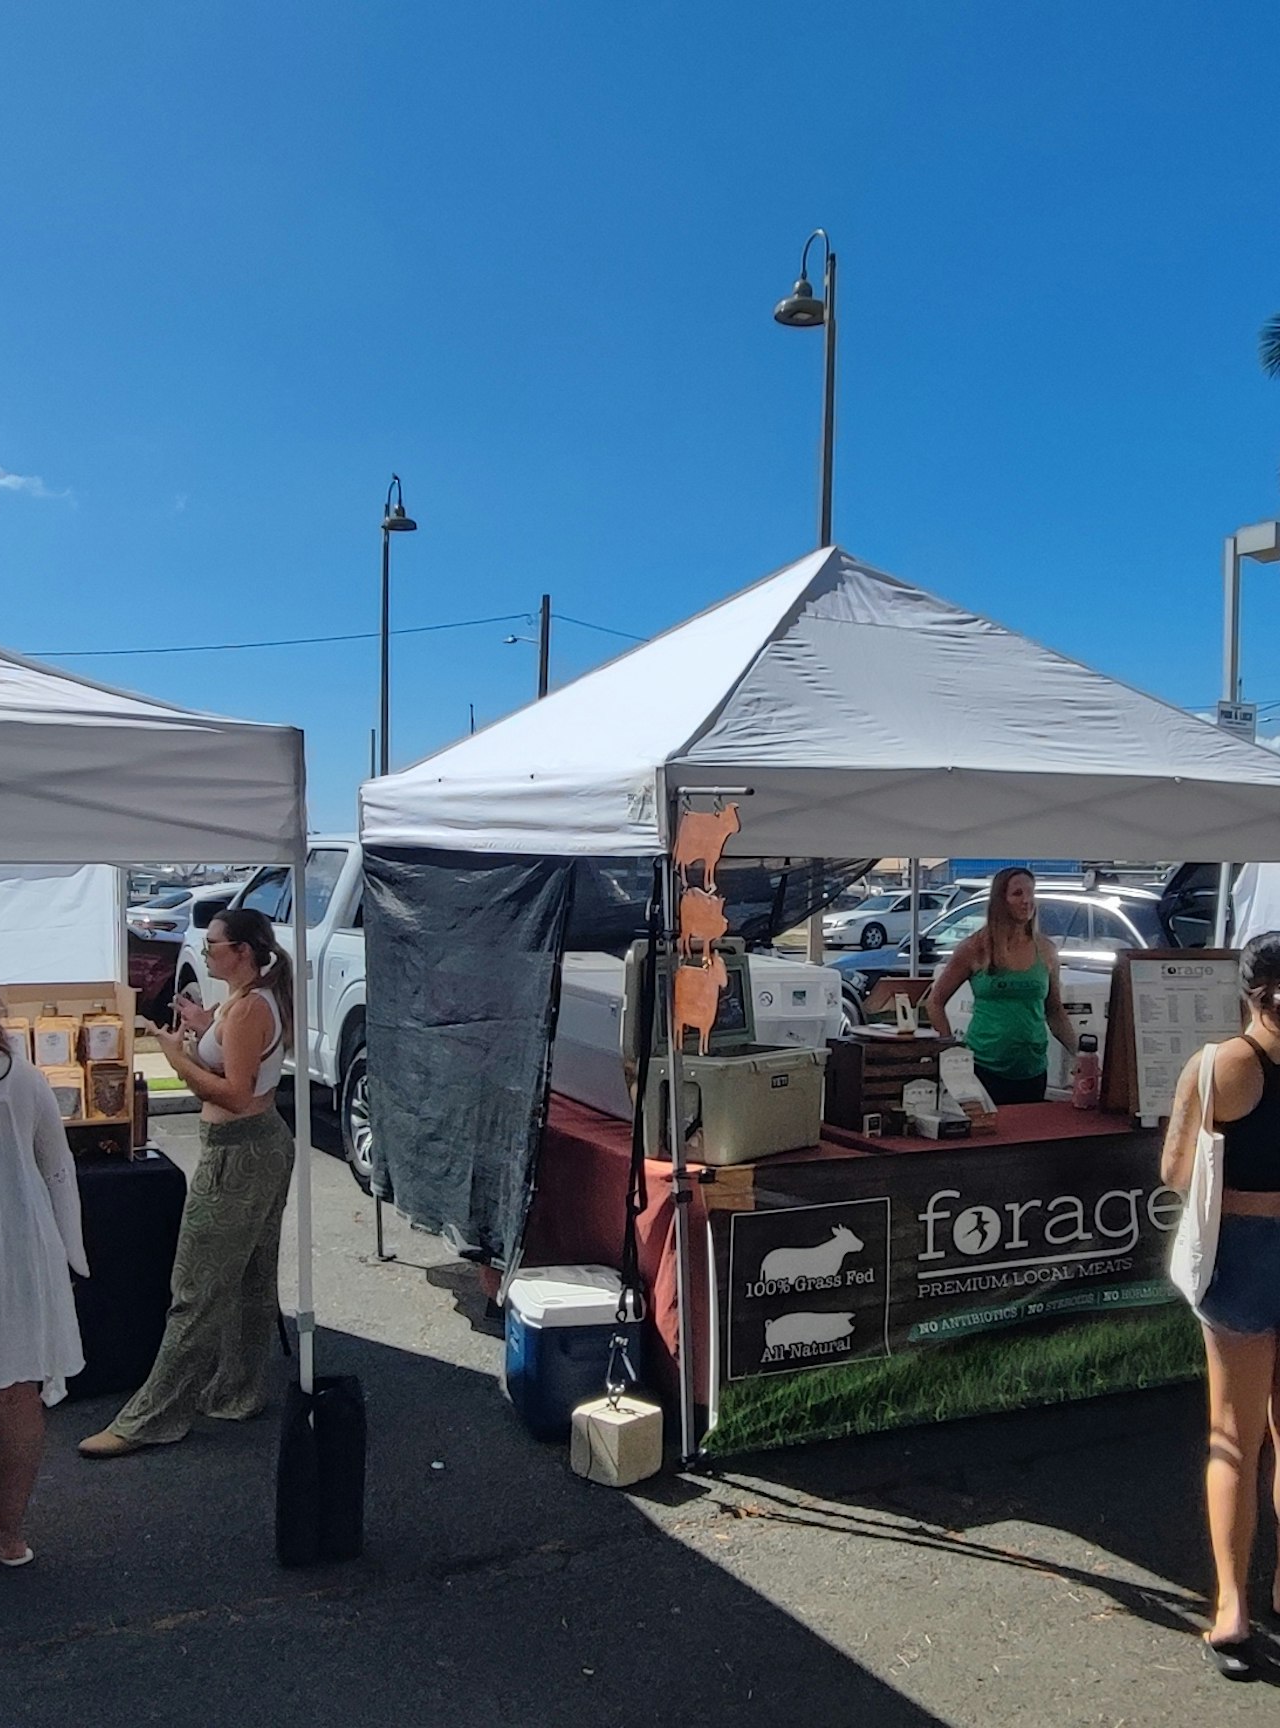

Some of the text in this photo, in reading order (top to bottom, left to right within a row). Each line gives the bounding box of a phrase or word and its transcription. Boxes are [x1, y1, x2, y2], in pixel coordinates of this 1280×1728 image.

[917, 1186, 1186, 1262] forage
[745, 1267, 875, 1298] 100% Grass Fed
[917, 1257, 1134, 1298] PREMIUM LOCAL MEATS
[918, 1322, 939, 1334] NO
[941, 1307, 1018, 1330] ANTIBIOTICS
[1026, 1302, 1044, 1315] NO
[1102, 1290, 1119, 1301] NO
[760, 1336, 851, 1363] All Natural
